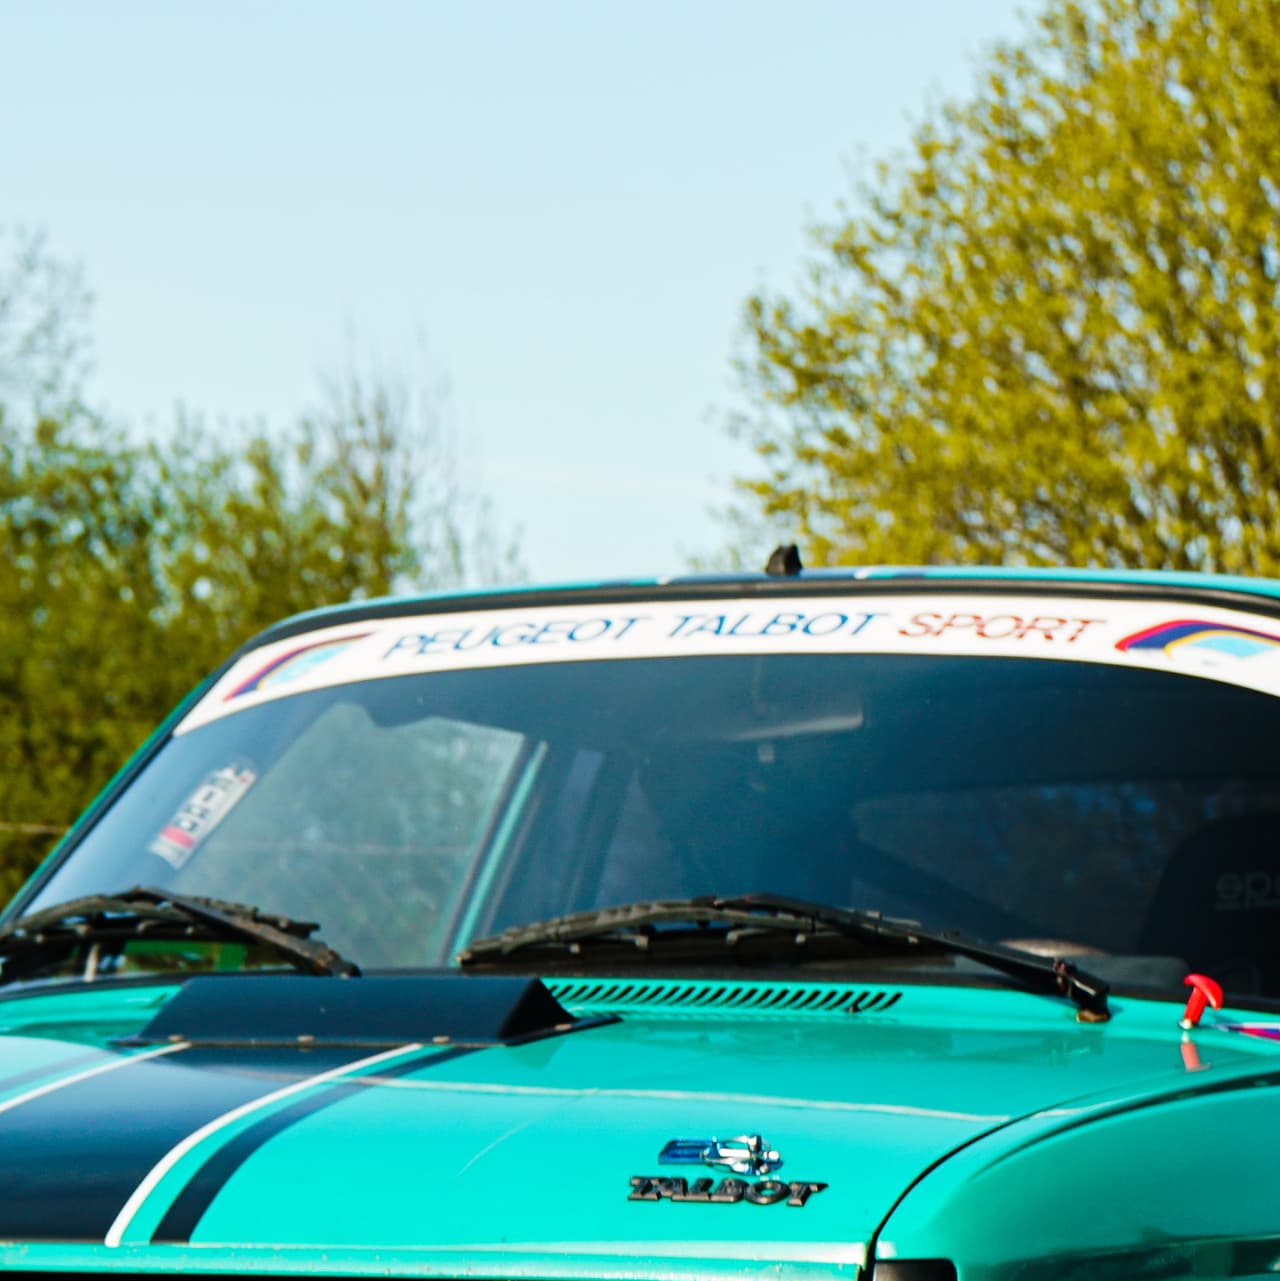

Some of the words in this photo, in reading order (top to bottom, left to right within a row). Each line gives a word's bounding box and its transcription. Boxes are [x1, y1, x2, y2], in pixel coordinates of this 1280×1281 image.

[381, 616, 652, 660] PEUGEOT
[669, 612, 889, 640] TALBOT
[898, 612, 1108, 643] SPORT
[627, 1176, 829, 1207] TALBOT
